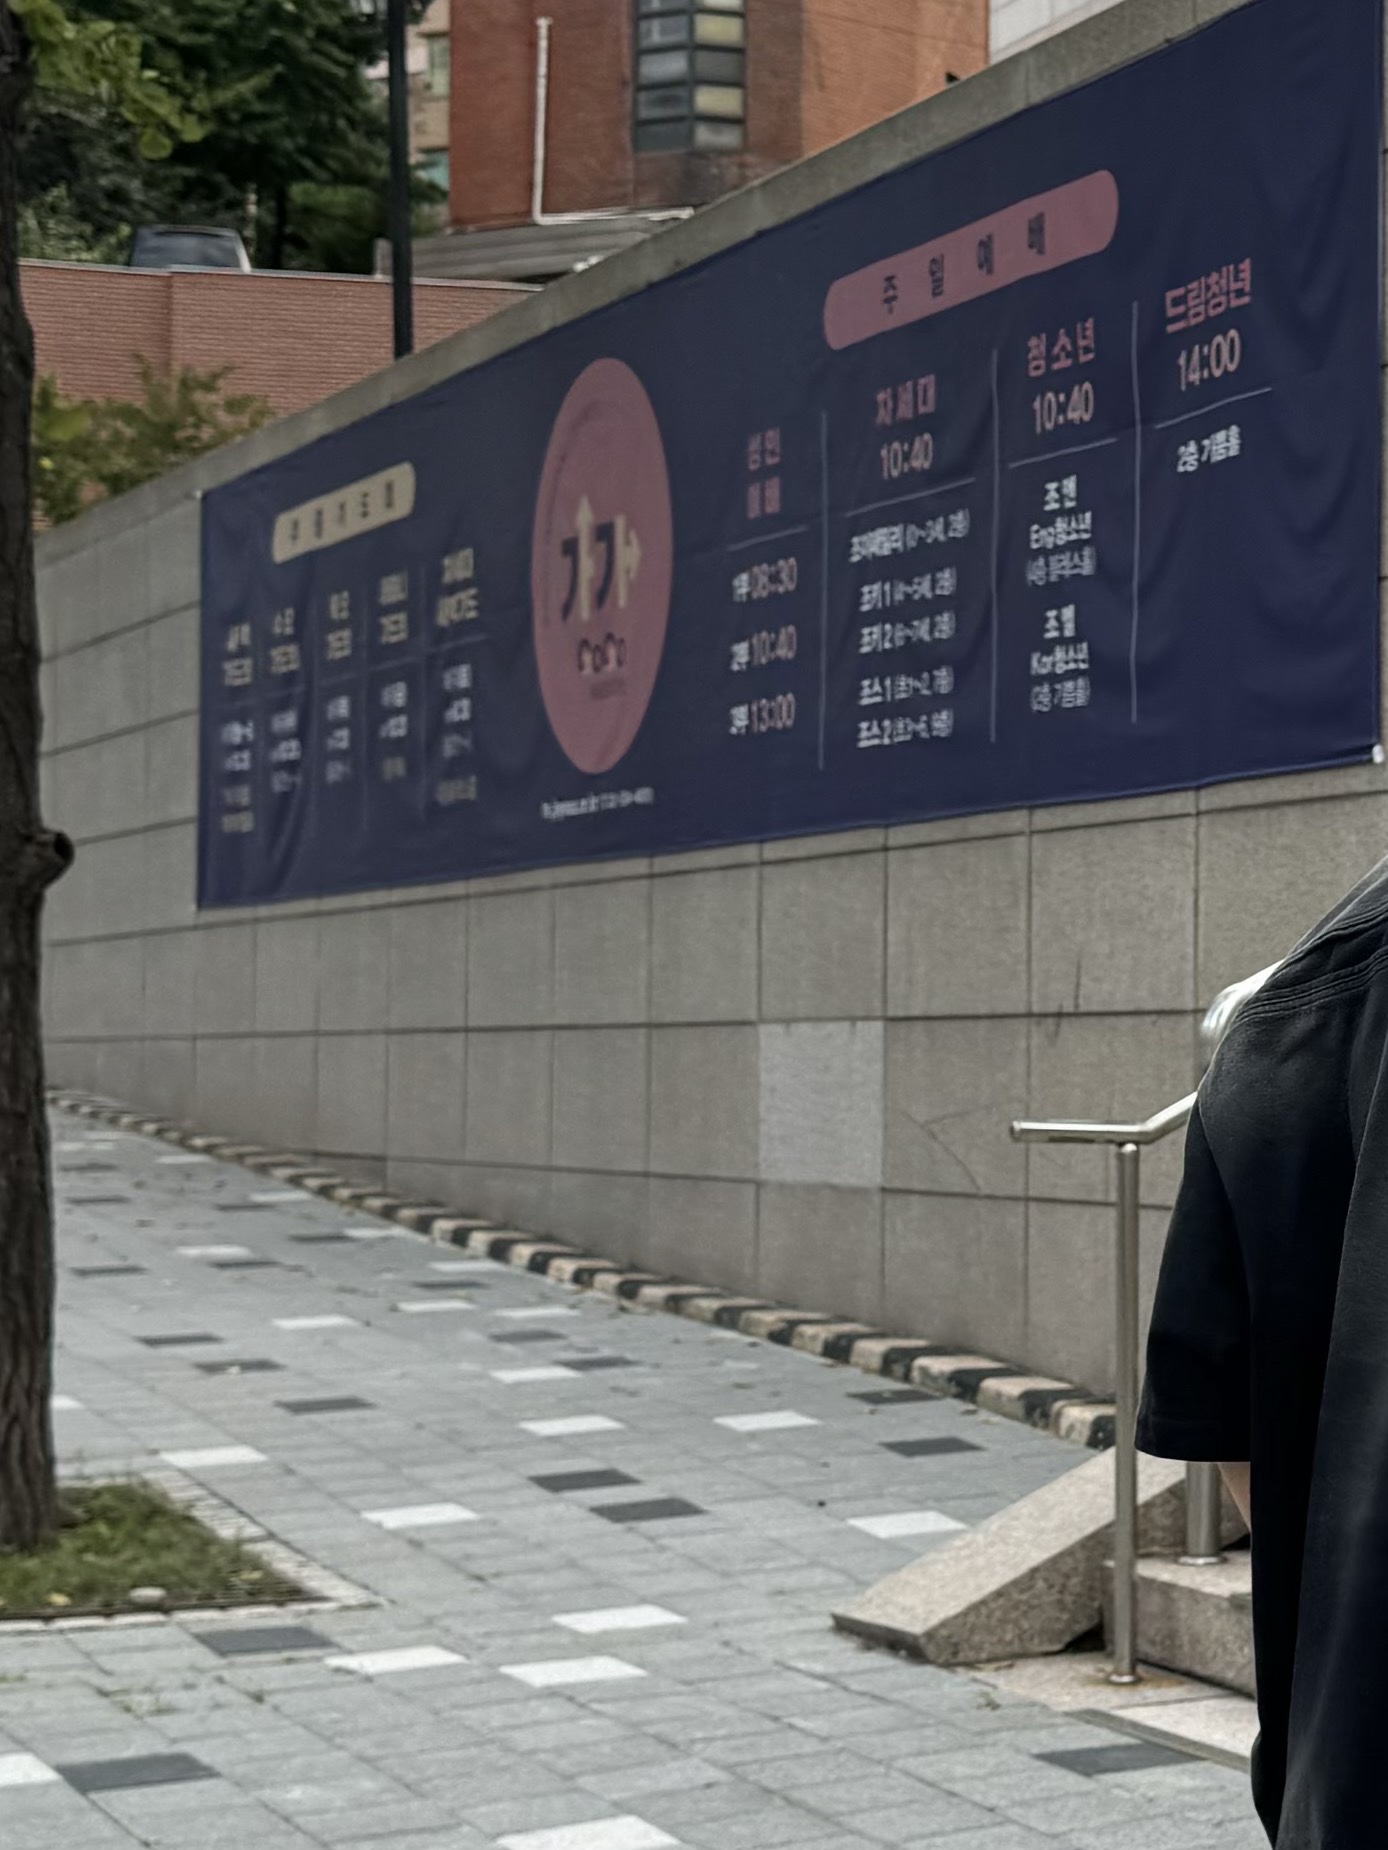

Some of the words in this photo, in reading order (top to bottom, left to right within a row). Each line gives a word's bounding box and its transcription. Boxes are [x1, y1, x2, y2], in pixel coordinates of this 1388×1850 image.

[1164, 258, 1252, 334] 드림청년
[1027, 317, 1096, 377] 청소년
[1176, 328, 1242, 392] 14:00
[1032, 381, 1095, 434] 10:40
[880, 432, 934, 480] 10:40
